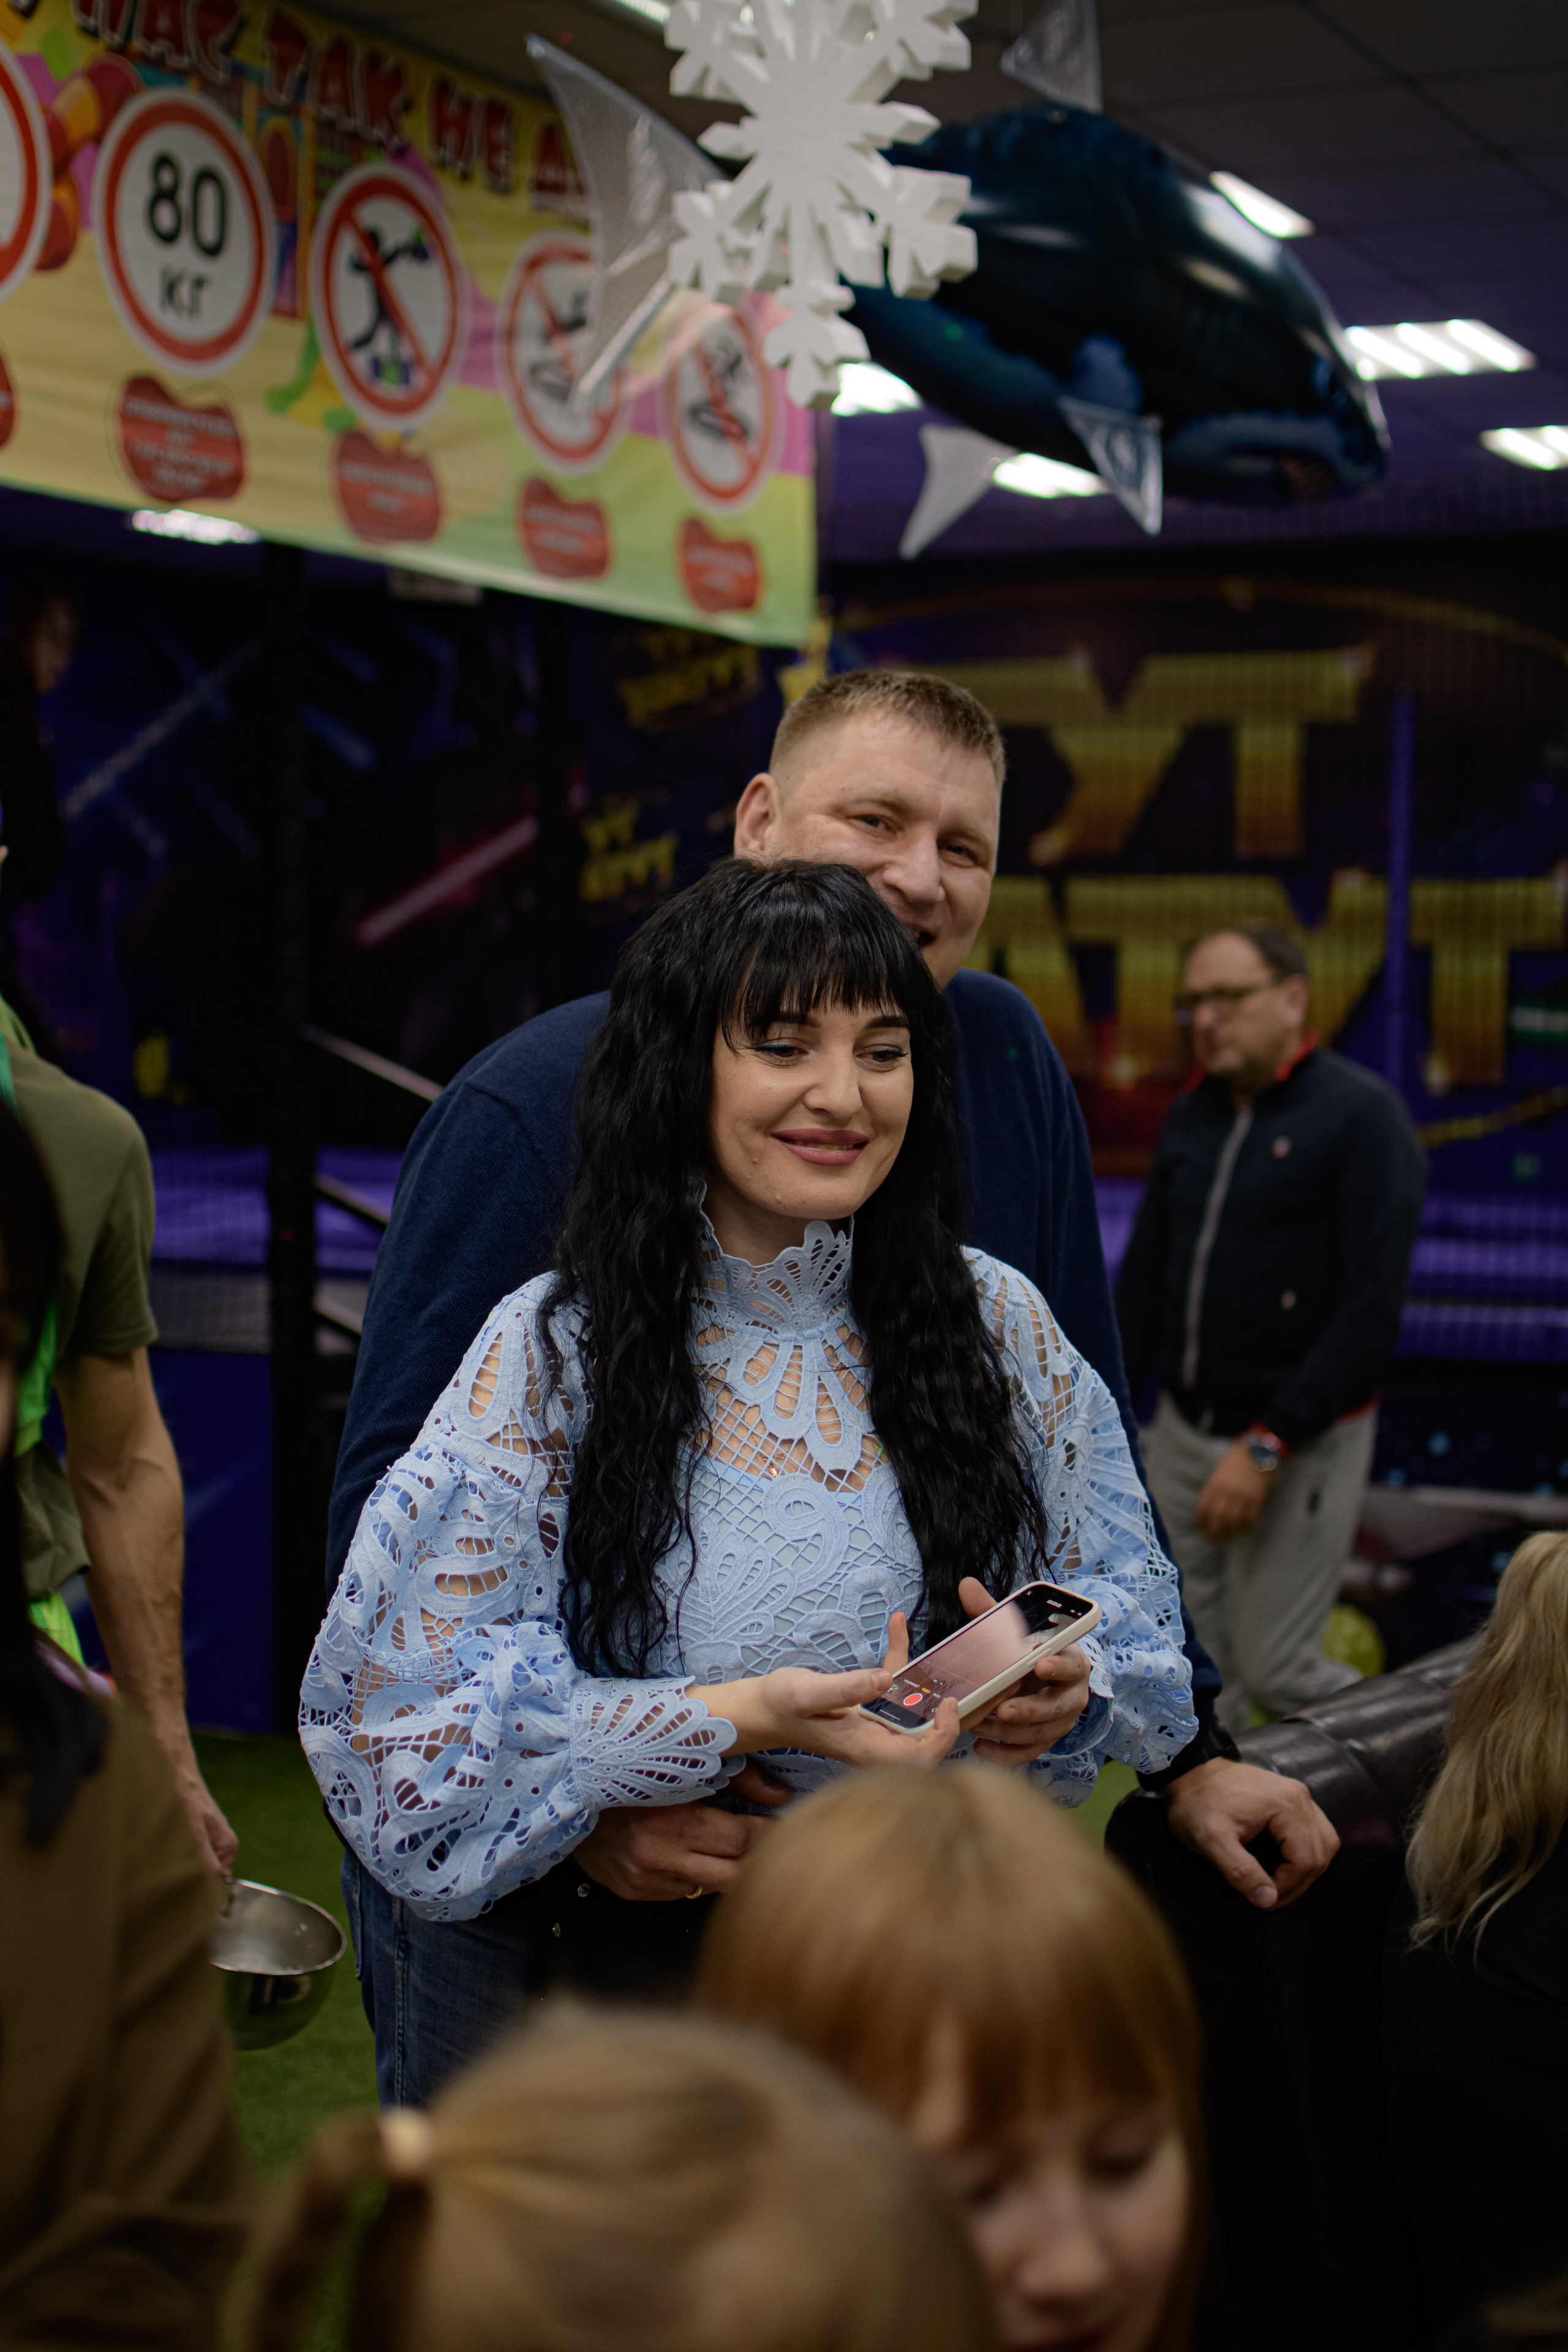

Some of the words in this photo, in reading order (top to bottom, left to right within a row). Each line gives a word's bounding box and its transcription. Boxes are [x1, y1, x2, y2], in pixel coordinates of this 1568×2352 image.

[263, 6, 409, 150] ТАК
[432, 77, 512, 194] НЕ
[149, 153, 225, 257] 80
